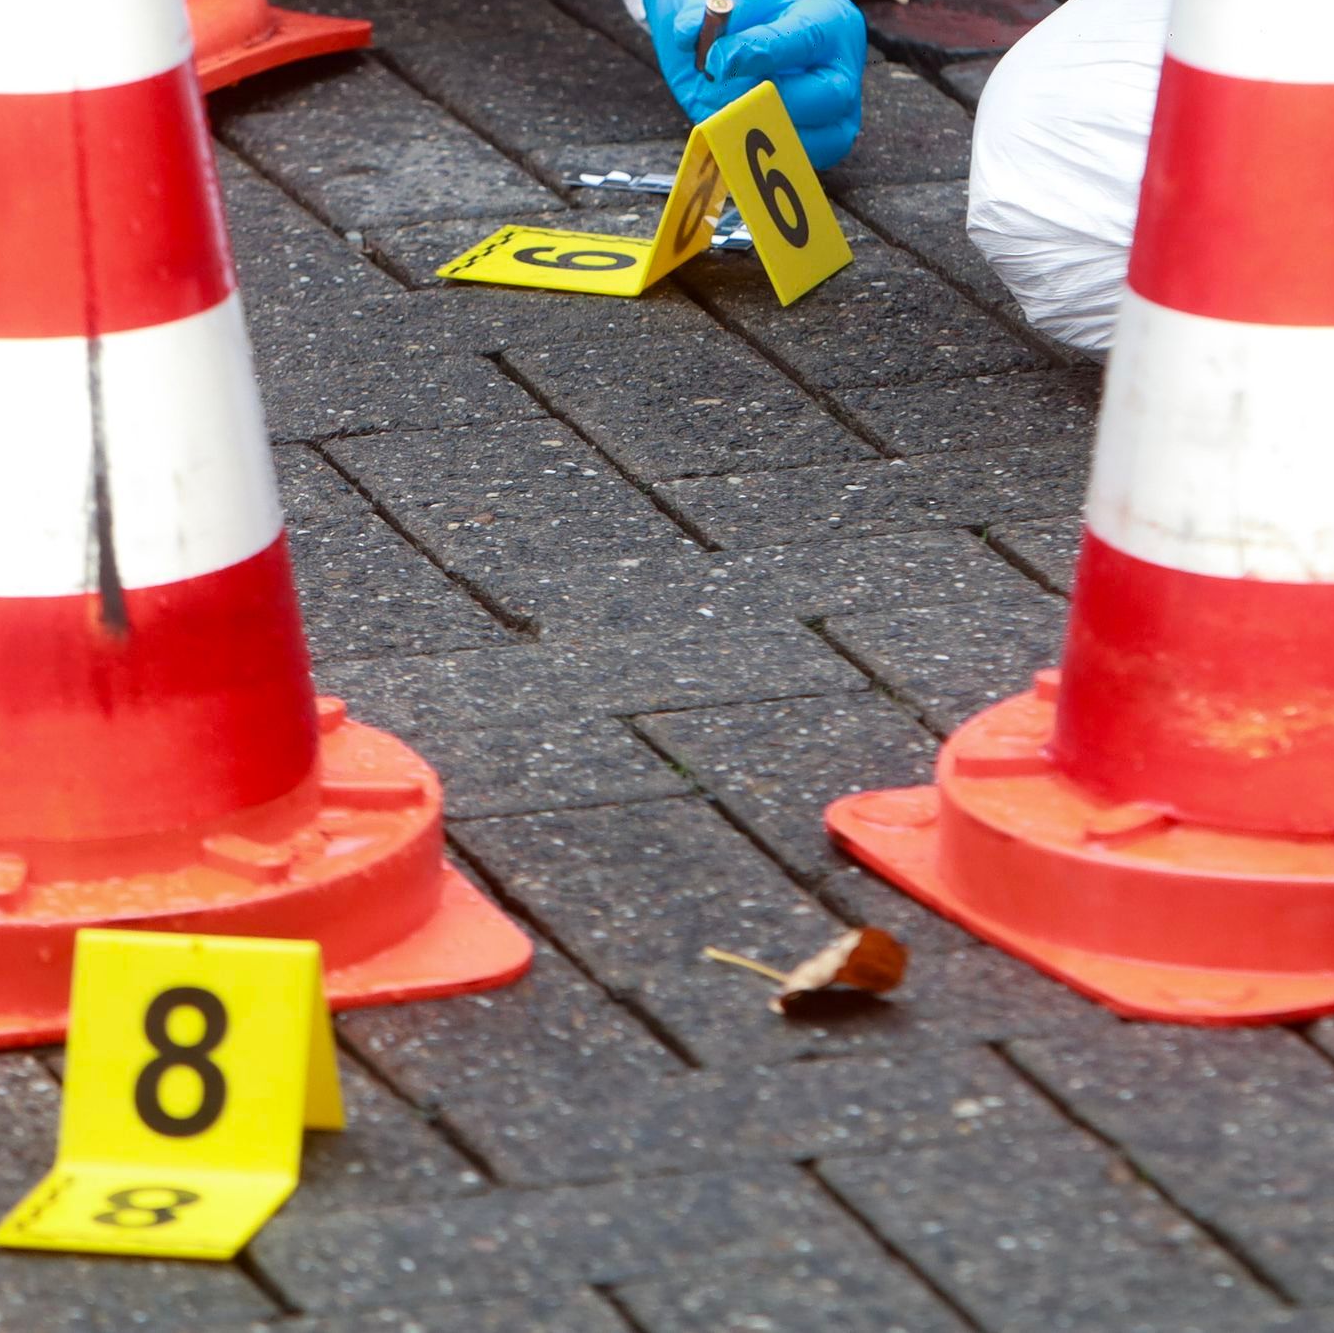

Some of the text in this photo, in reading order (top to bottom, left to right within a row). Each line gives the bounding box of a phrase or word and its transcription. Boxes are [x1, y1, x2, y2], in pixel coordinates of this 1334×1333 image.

[745, 128, 810, 249] 6
[133, 985, 230, 1138] 8
[92, 1187, 202, 1228] 8
